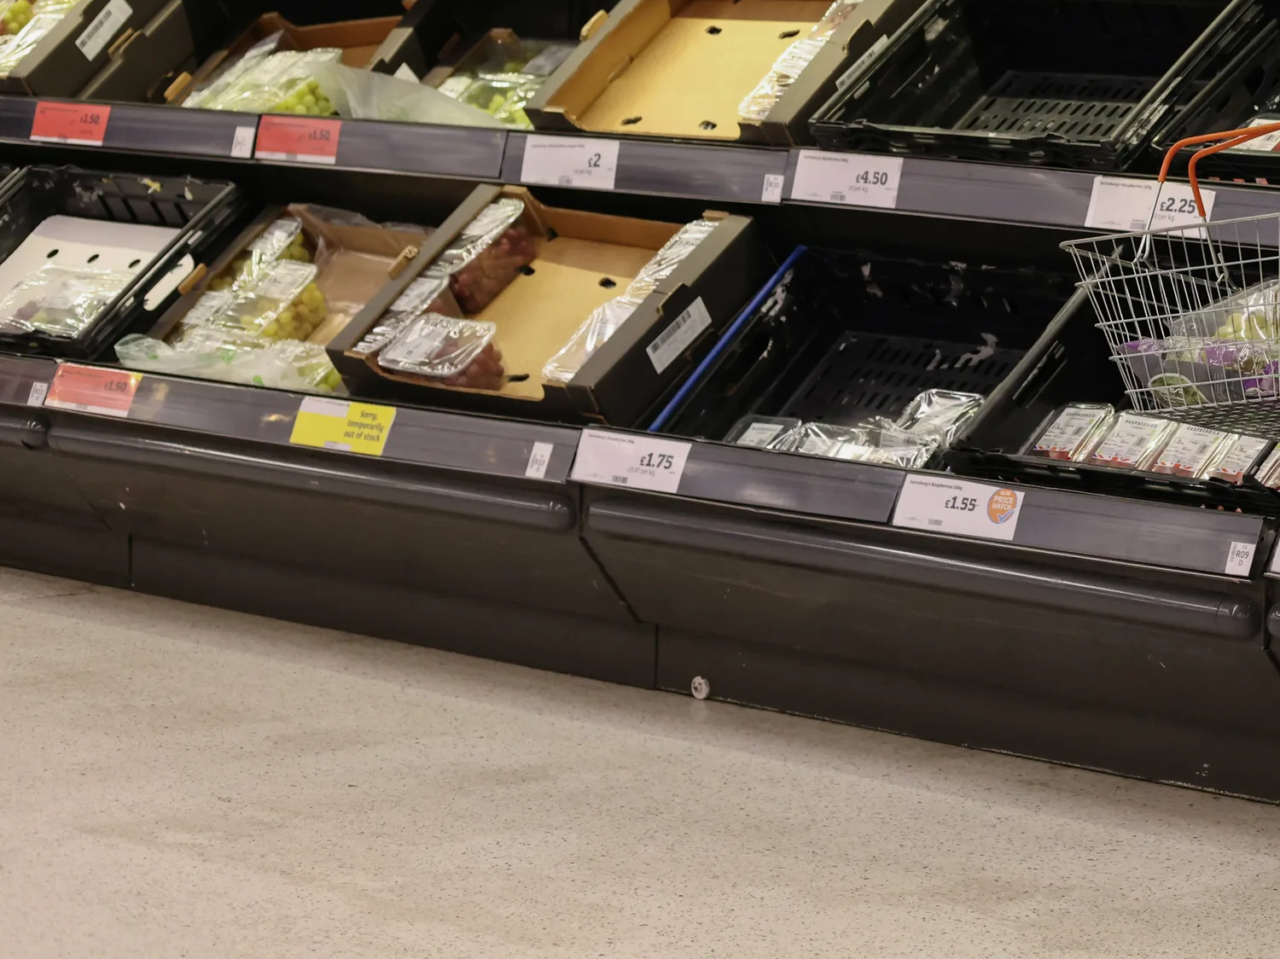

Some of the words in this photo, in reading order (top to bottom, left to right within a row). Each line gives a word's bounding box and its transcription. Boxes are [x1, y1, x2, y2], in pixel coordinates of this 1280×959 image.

[587, 152, 602, 168] £2
[855, 170, 889, 186] £4.50
[1159, 197, 1197, 214] £2.25
[639, 452, 675, 470] £1.75
[944, 496, 977, 512] £1.55
[992, 502, 1012, 511] MATCH
[993, 495, 1014, 505] PRICE
[1235, 550, 1250, 559] R09
